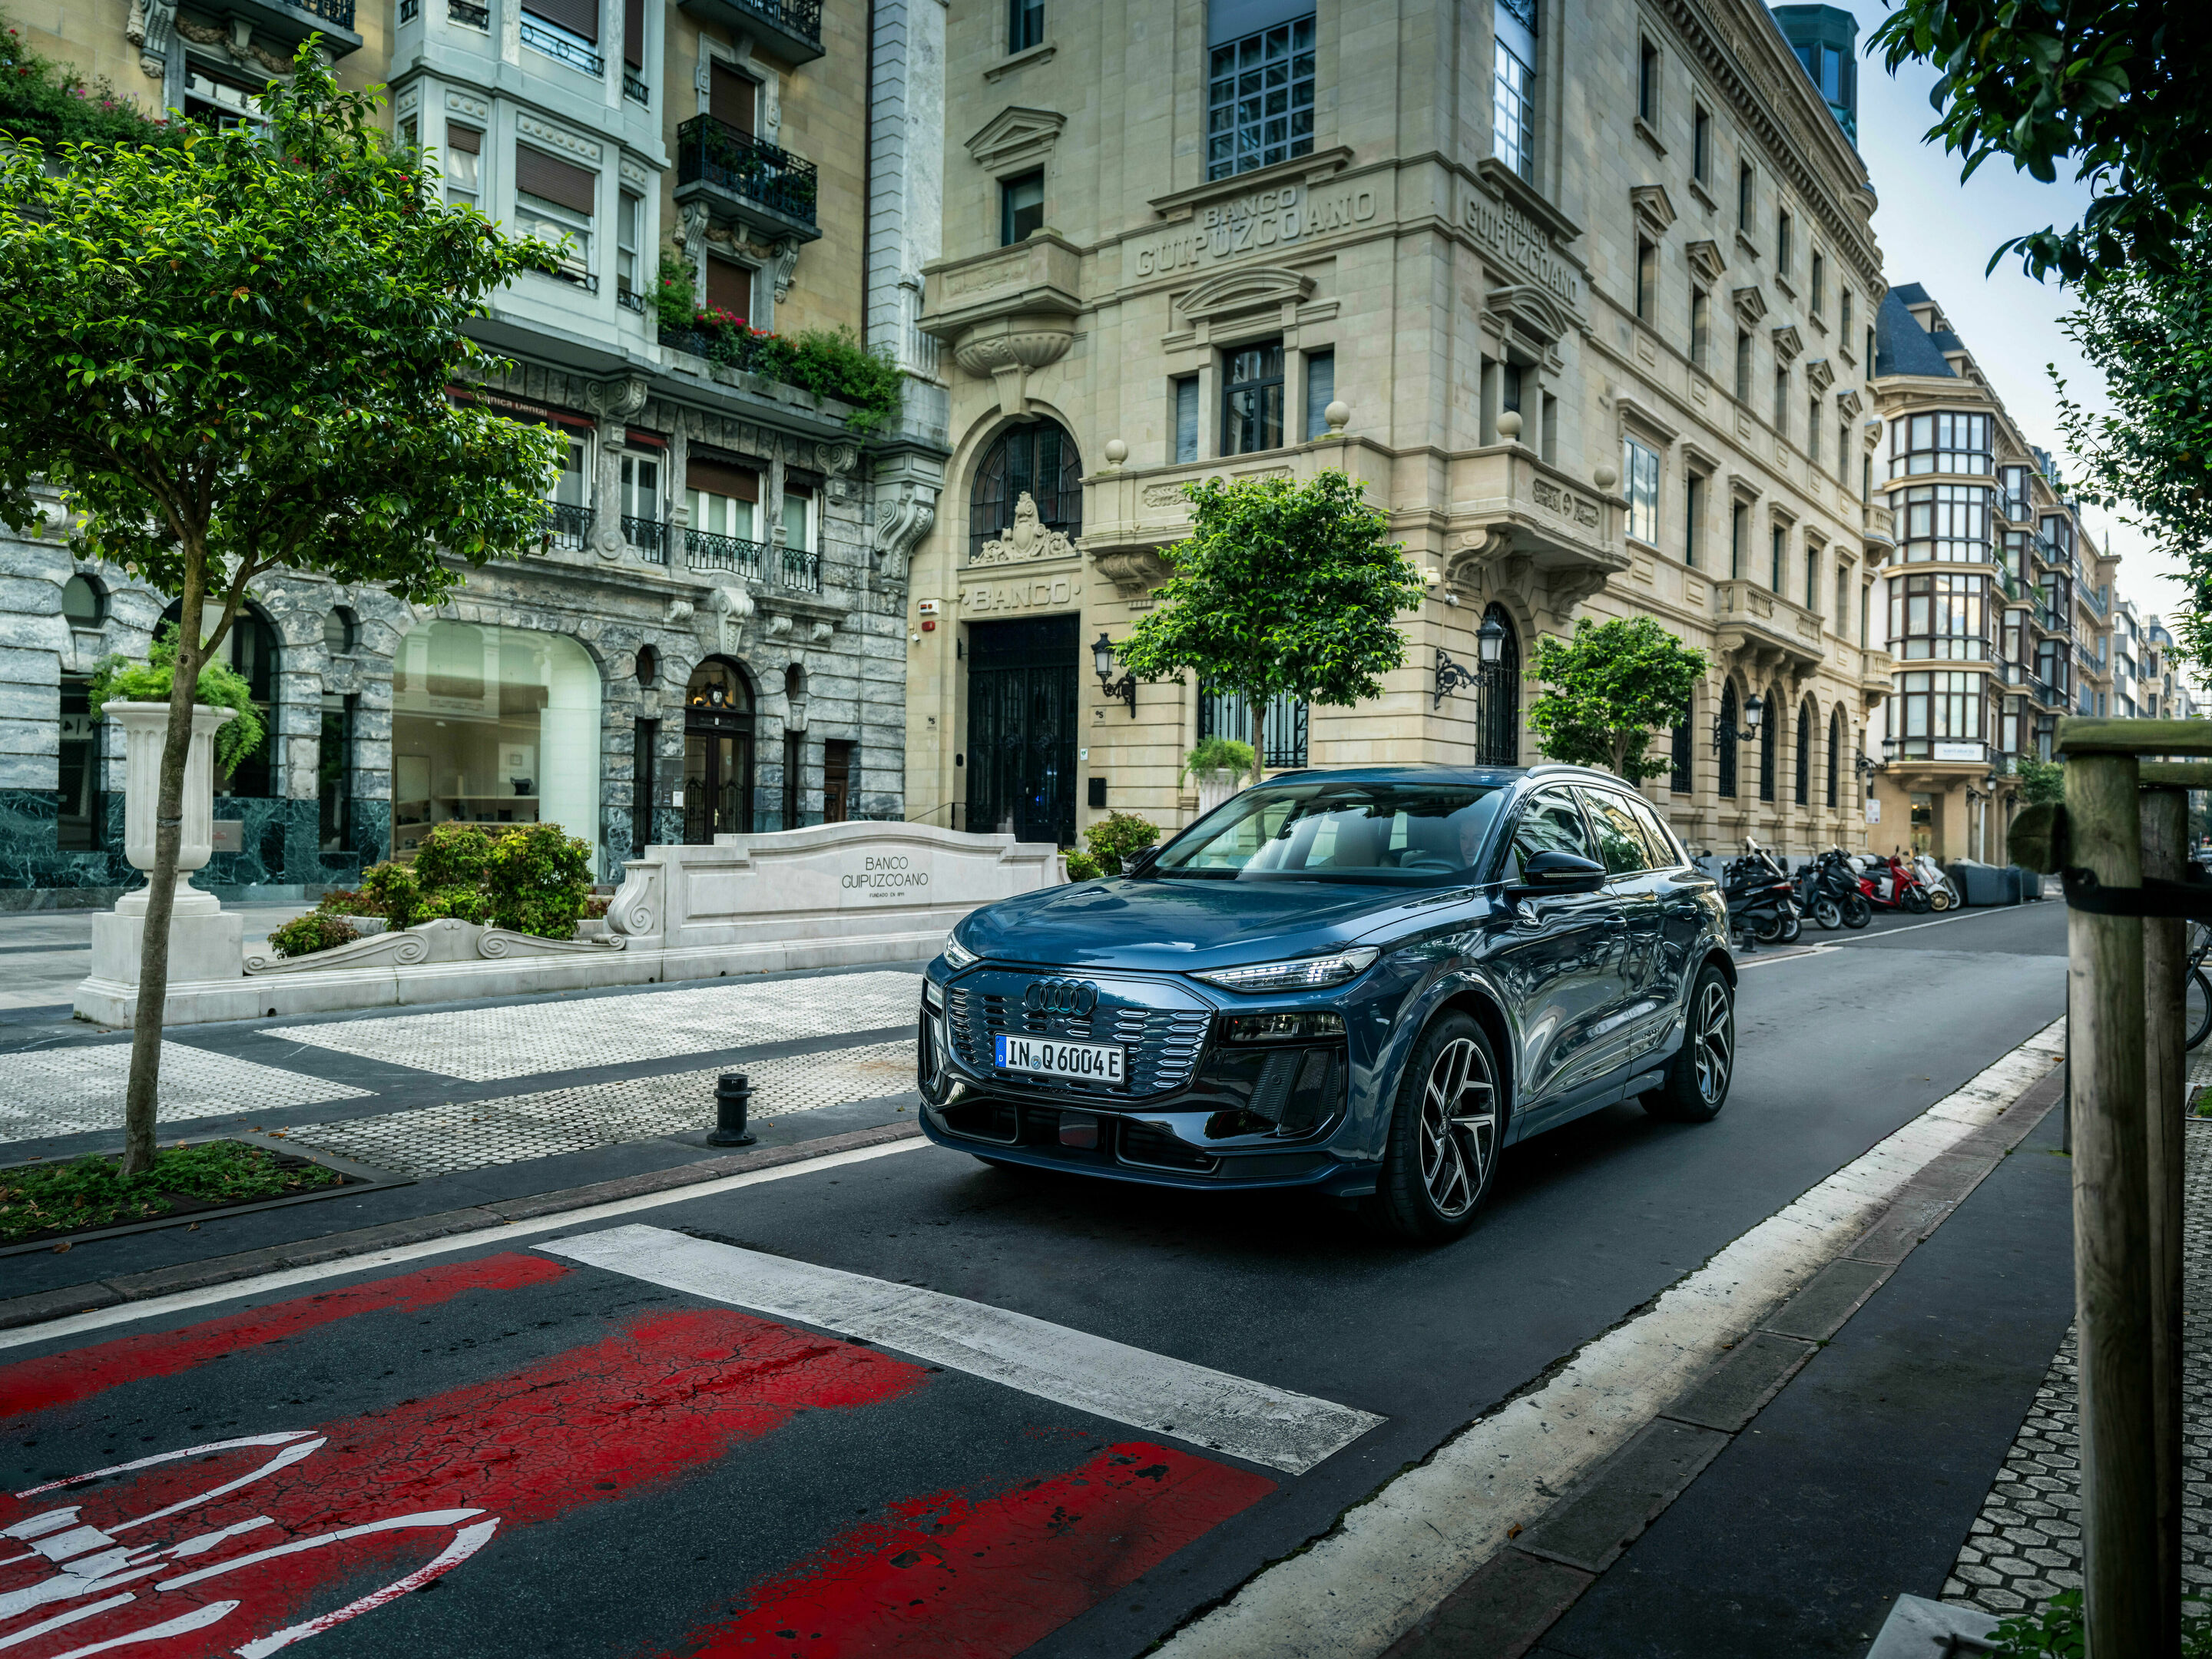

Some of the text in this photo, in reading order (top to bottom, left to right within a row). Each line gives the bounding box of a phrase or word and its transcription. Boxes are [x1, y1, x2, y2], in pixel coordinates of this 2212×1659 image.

[1204, 184, 1297, 230] BANCO
[1503, 200, 1548, 253] BANCO
[1135, 189, 1377, 276] GUIPUZCOANO
[1465, 198, 1577, 306] GUIPUZCOANO
[972, 578, 1071, 611] BANCO
[842, 873, 929, 889] GUIPUZCOANO
[866, 856, 909, 871] BANCO
